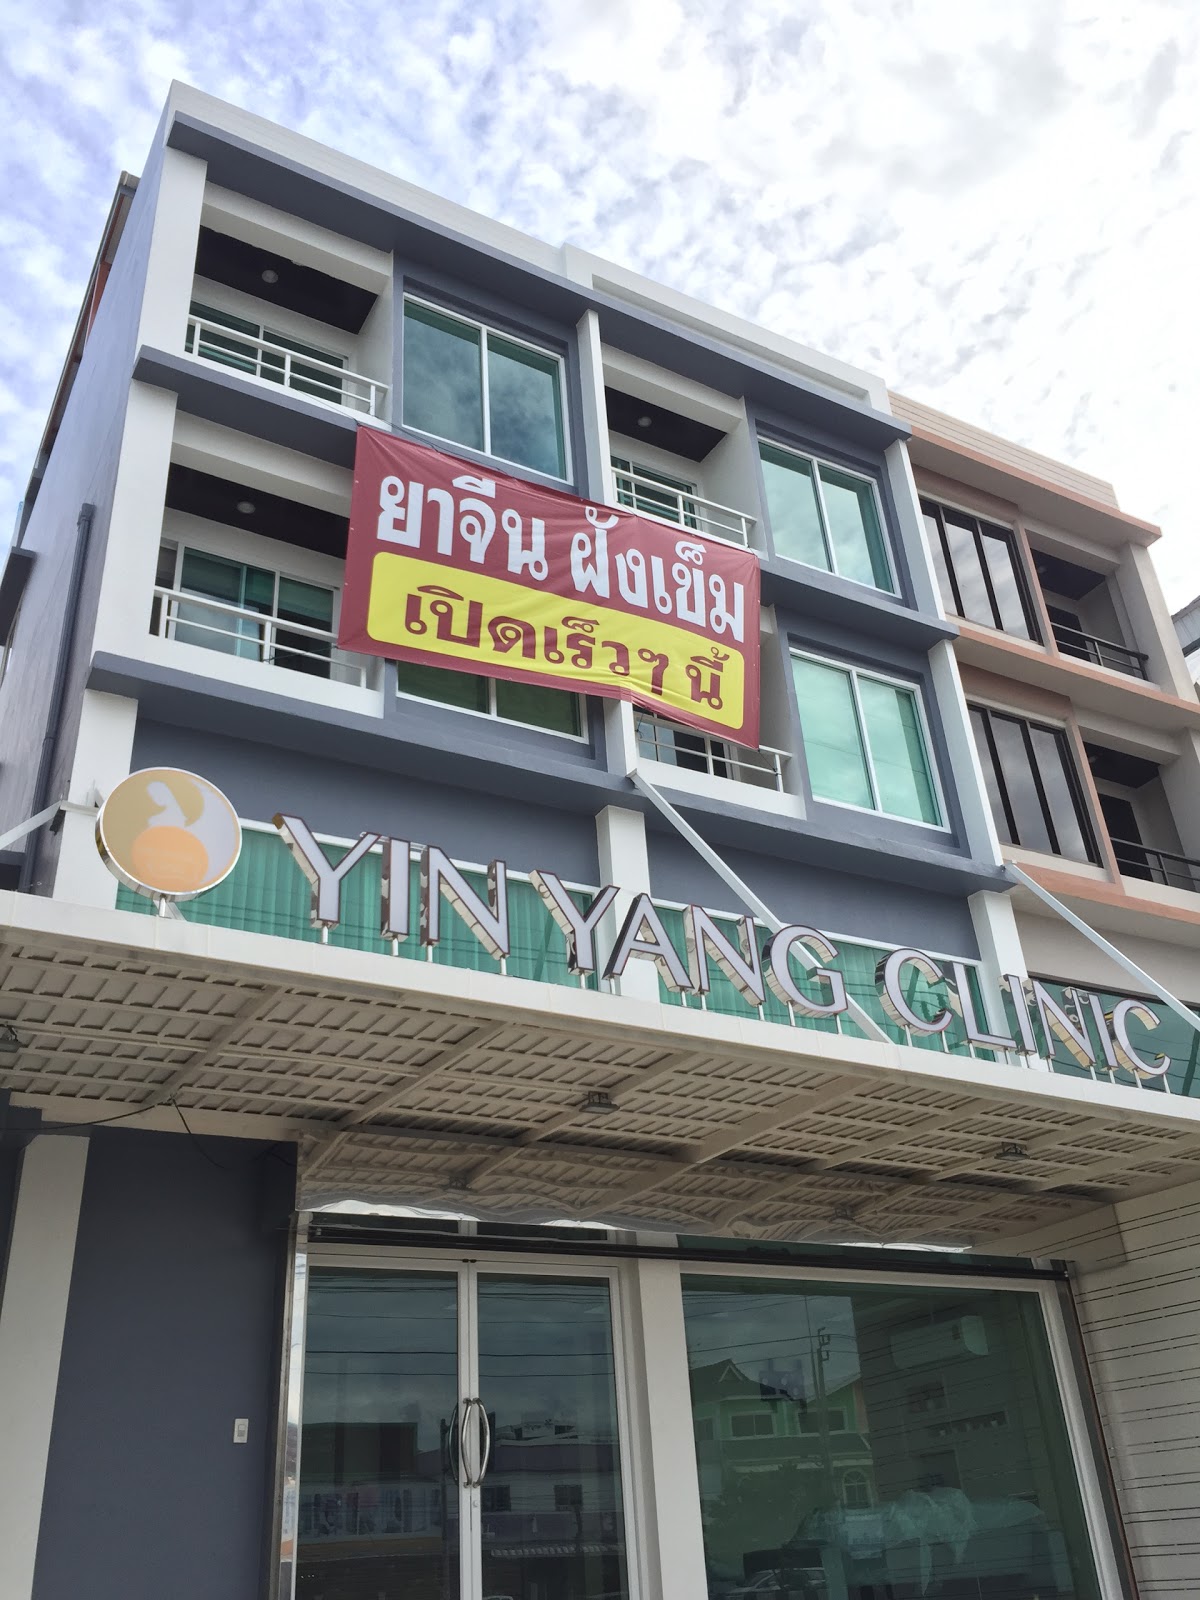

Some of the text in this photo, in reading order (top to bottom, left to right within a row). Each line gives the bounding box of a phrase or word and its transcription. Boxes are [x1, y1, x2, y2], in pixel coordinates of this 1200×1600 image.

[376, 475, 744, 643] ยาจีน ฝังเข็ม
[274, 812, 1172, 1077] YIN YANG CLINIC
